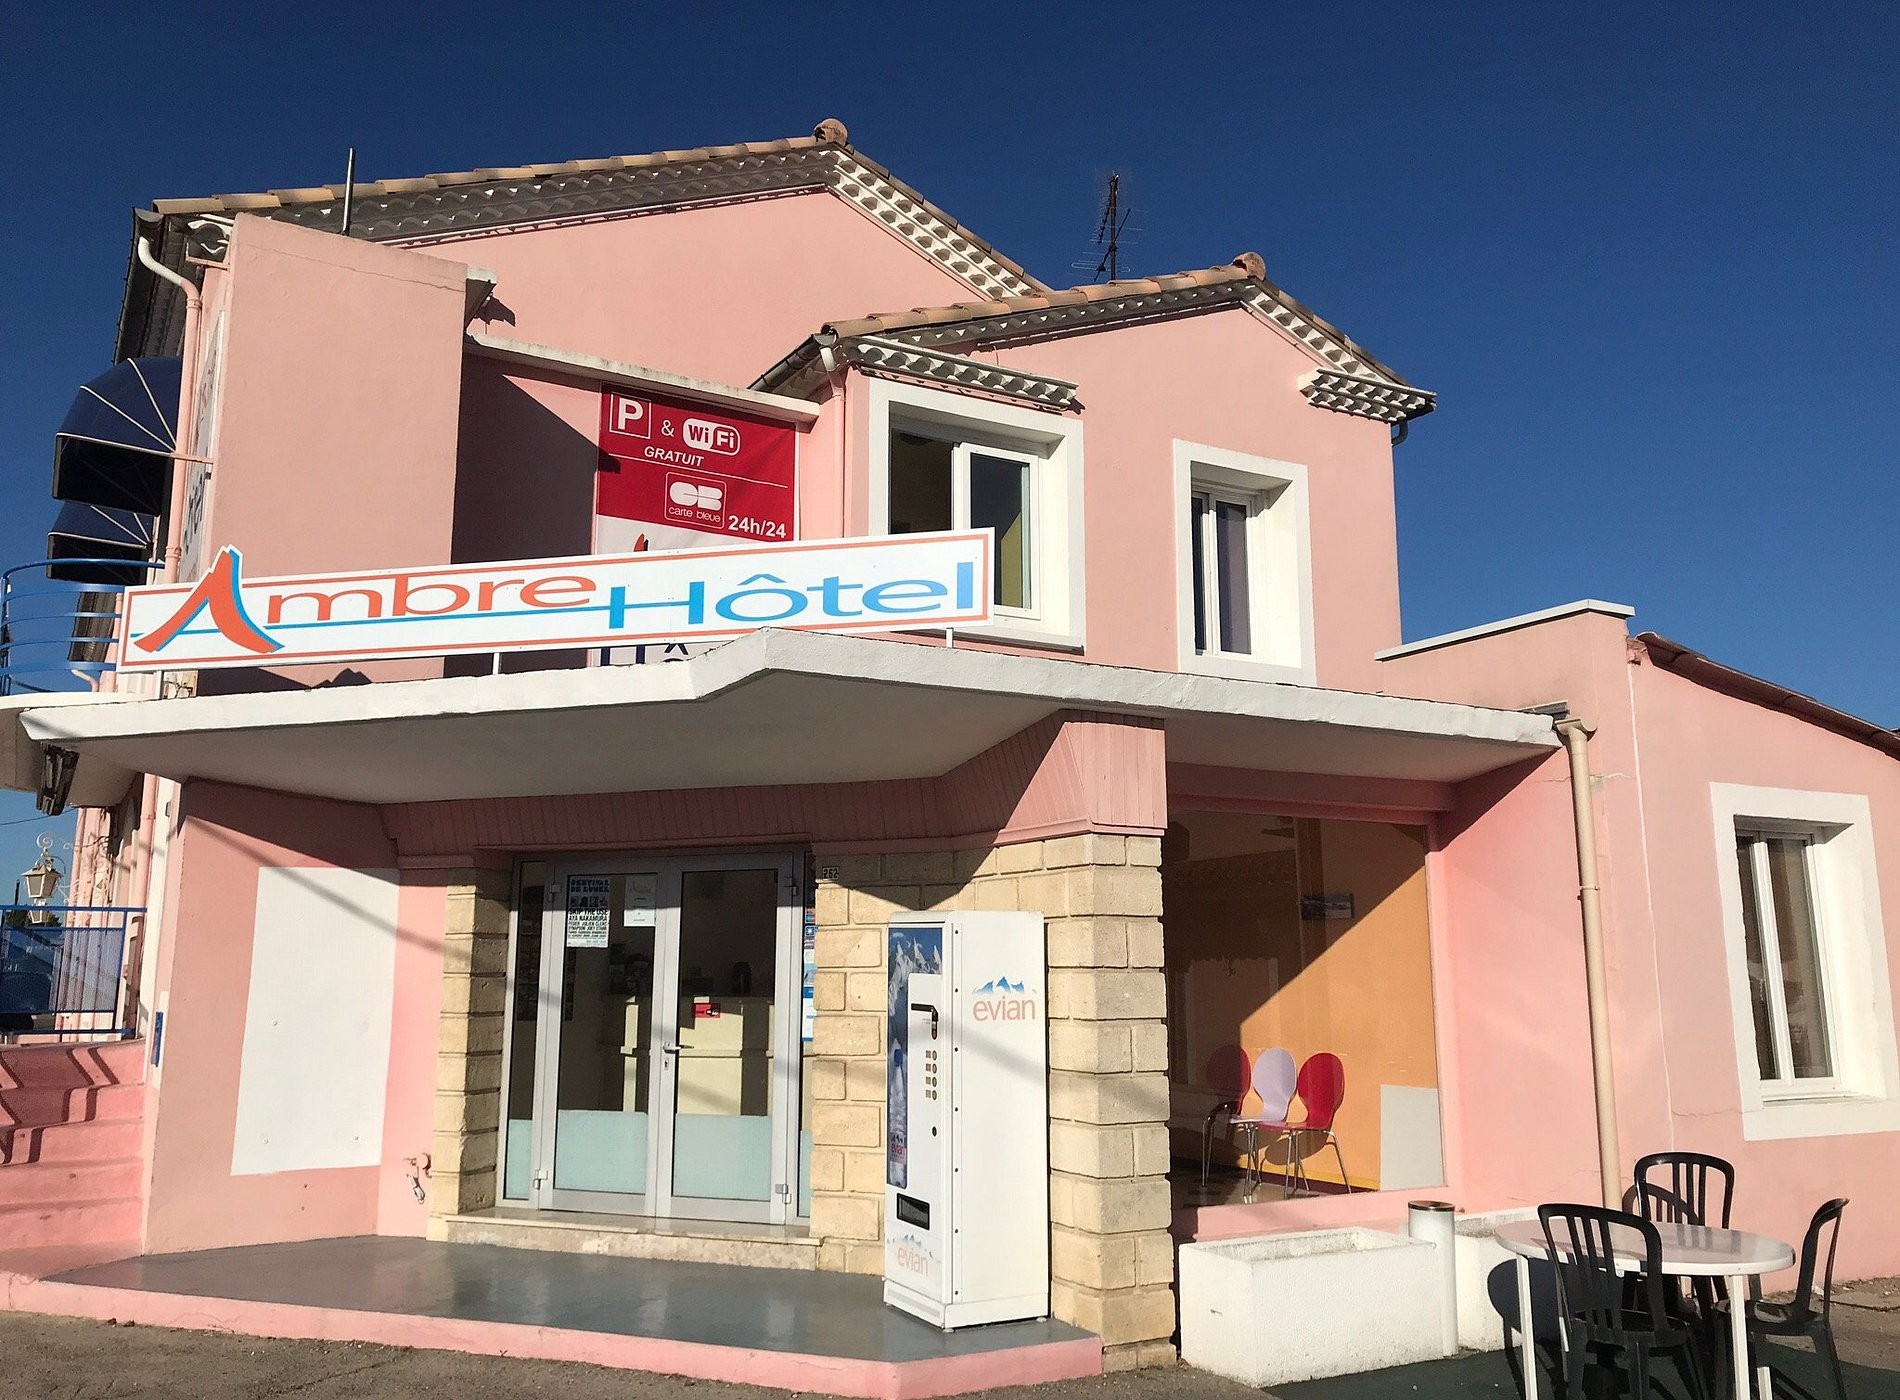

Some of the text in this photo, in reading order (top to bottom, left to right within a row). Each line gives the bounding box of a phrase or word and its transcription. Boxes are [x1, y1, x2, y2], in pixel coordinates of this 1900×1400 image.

[618, 397, 644, 430] P
[661, 419, 675, 438] &
[644, 446, 704, 467] GRATUIT
[668, 506, 721, 523] carte bleue
[728, 515, 787, 539] 24h/24
[131, 546, 974, 653] Ambre Hôtel
[585, 907, 595, 915] THE
[597, 907, 608, 915] USE
[973, 995, 1036, 1021] evian
[897, 1247, 929, 1278] evian
